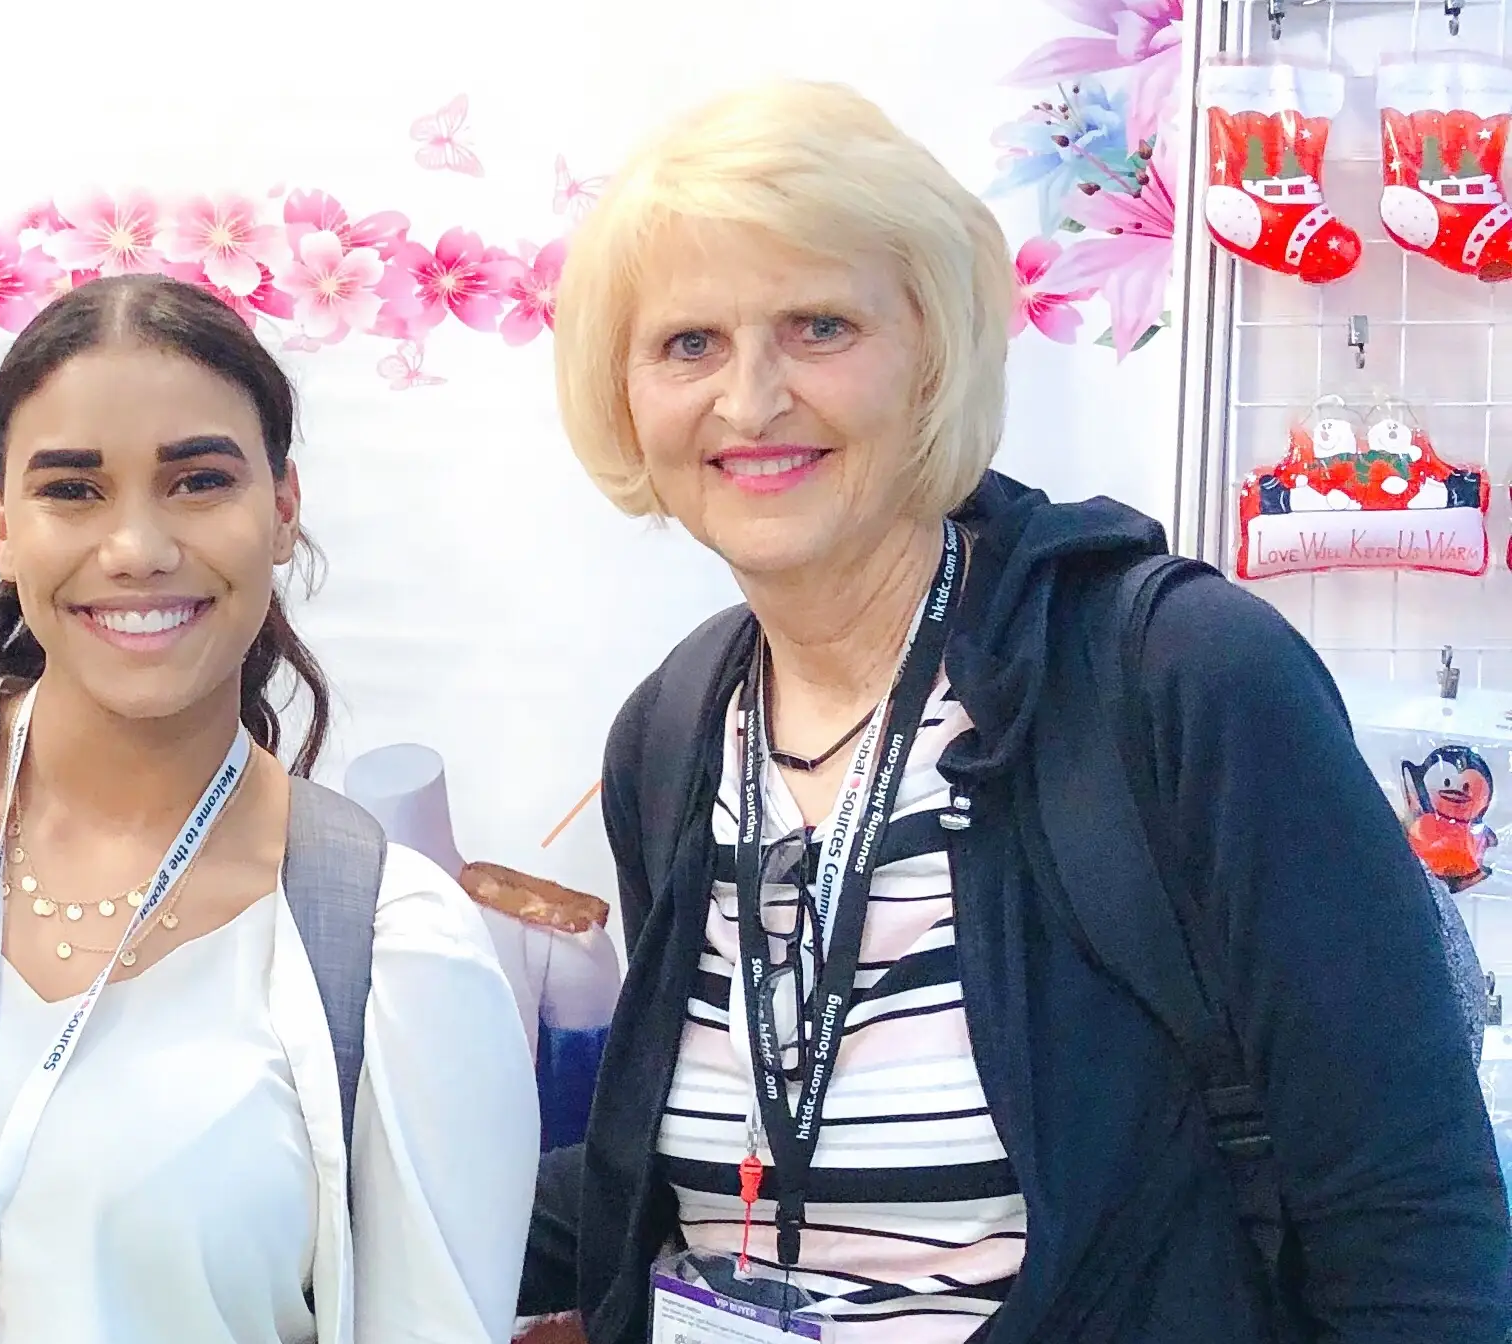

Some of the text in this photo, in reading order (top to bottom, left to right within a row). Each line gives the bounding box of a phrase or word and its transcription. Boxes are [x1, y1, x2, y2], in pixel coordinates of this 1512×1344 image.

[929, 554, 958, 622] hktdc.com
[742, 782, 758, 844] Sourcing
[827, 789, 857, 860] sources
[854, 733, 905, 875] sourcing.hktdc.com
[139, 763, 238, 921] Welcome to the global
[43, 1010, 85, 1072] sources
[796, 993, 843, 1140] hktdc.com Sourcing
[729, 1300, 758, 1318] BUYER
